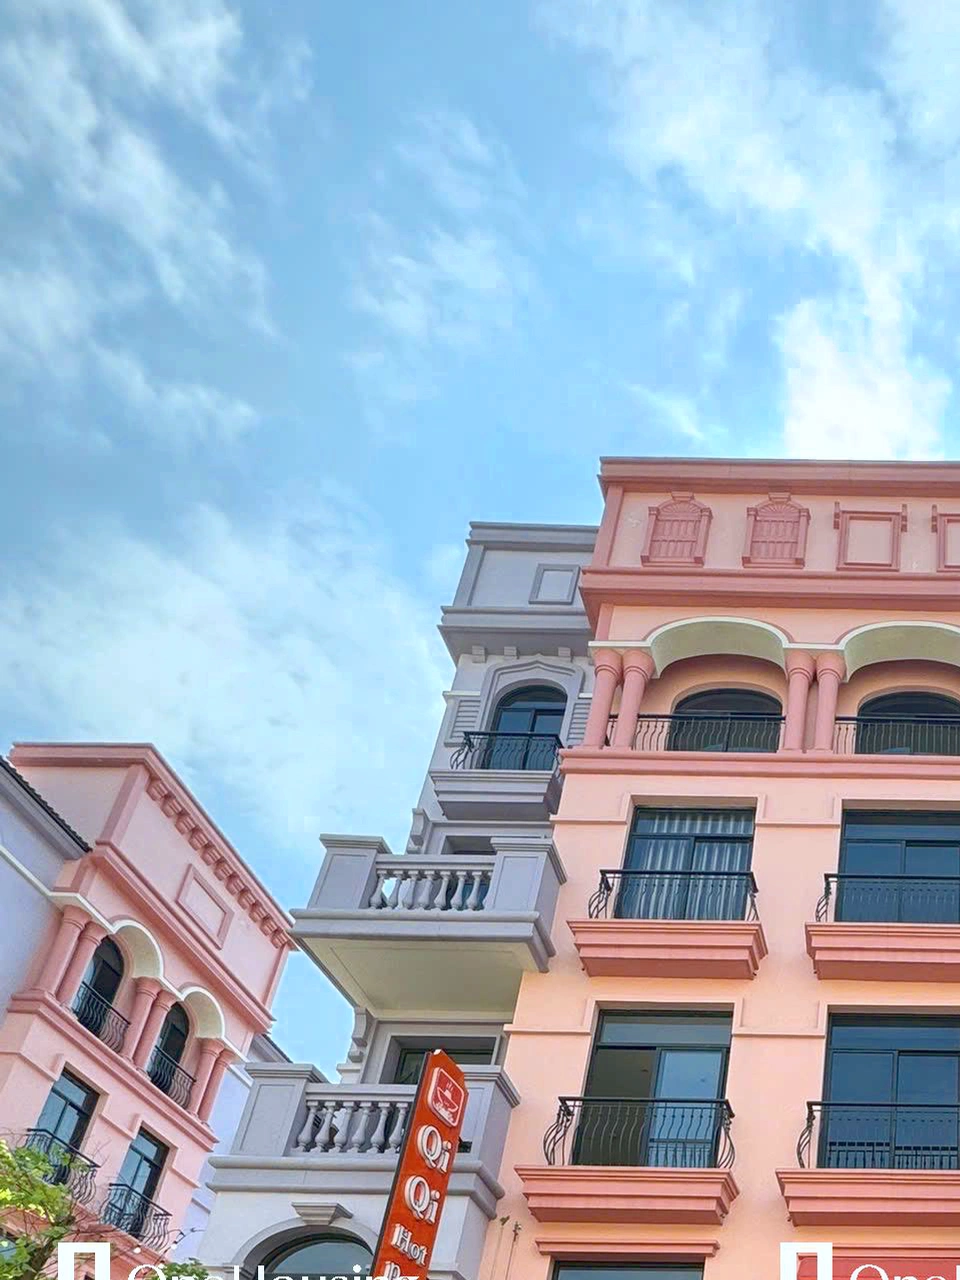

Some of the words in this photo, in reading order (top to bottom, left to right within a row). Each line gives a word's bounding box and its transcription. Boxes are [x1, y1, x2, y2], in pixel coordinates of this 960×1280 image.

[417, 1124, 452, 1173] Qi
[404, 1174, 440, 1223] Qi
[391, 1223, 428, 1267] Hot
